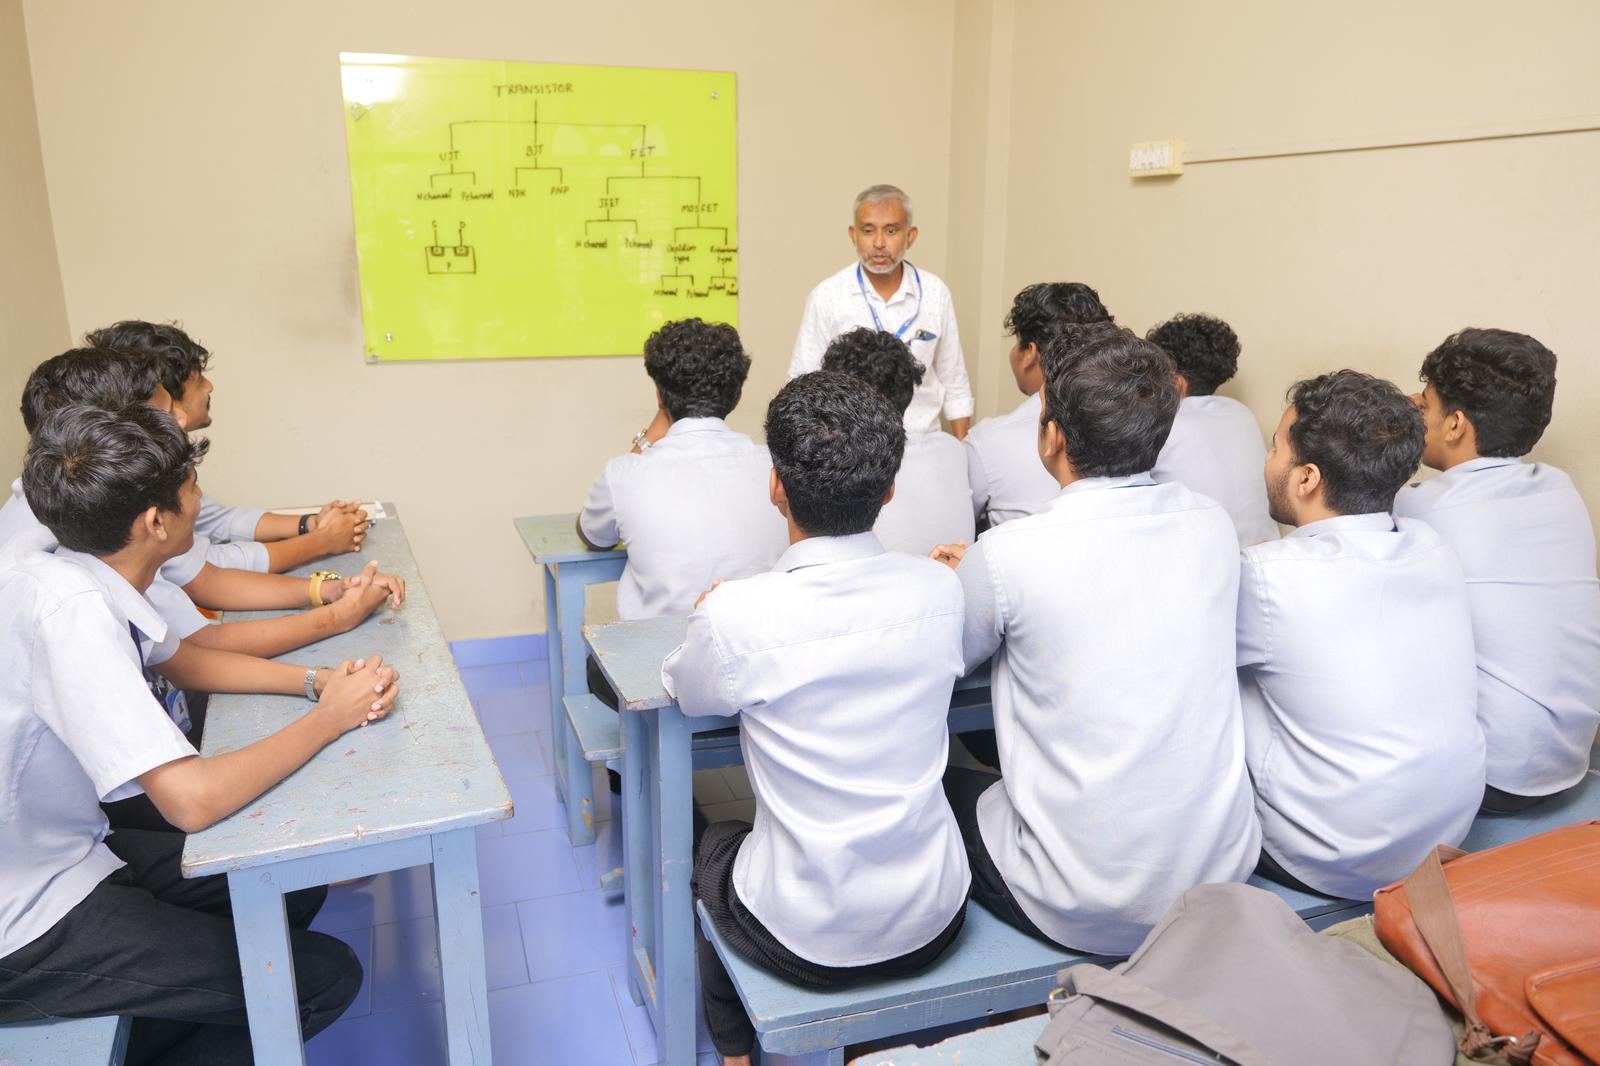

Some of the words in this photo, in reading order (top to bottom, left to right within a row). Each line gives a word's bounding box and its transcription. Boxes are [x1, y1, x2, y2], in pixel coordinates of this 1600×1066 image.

[493, 82, 574, 97] TRANSISTOR
[439, 150, 460, 161] UJT
[526, 144, 544, 157] BJT
[630, 145, 656, 160] FET
[598, 197, 620, 209] JFET
[681, 202, 718, 213] MOSFET
